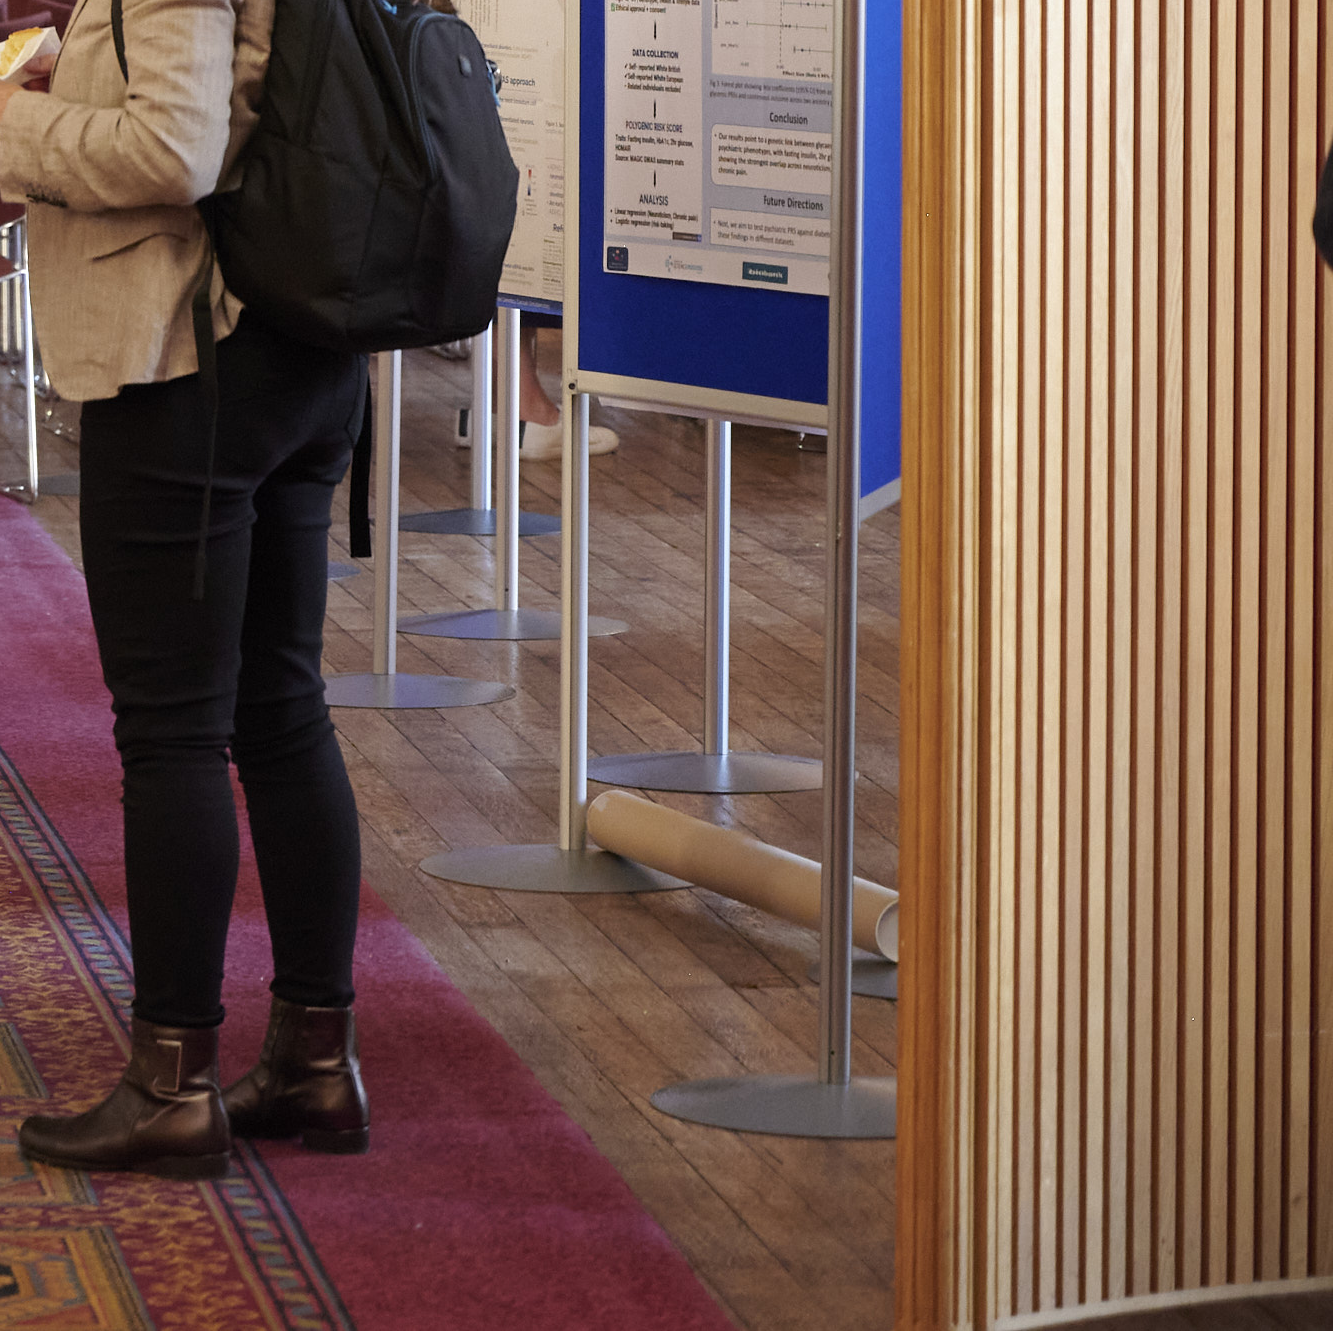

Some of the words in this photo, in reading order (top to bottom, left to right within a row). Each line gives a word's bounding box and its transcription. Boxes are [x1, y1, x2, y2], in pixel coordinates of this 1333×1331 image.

[770, 113, 808, 126] Conclusion
[764, 195, 785, 208] Future
[787, 198, 823, 211] Directions
